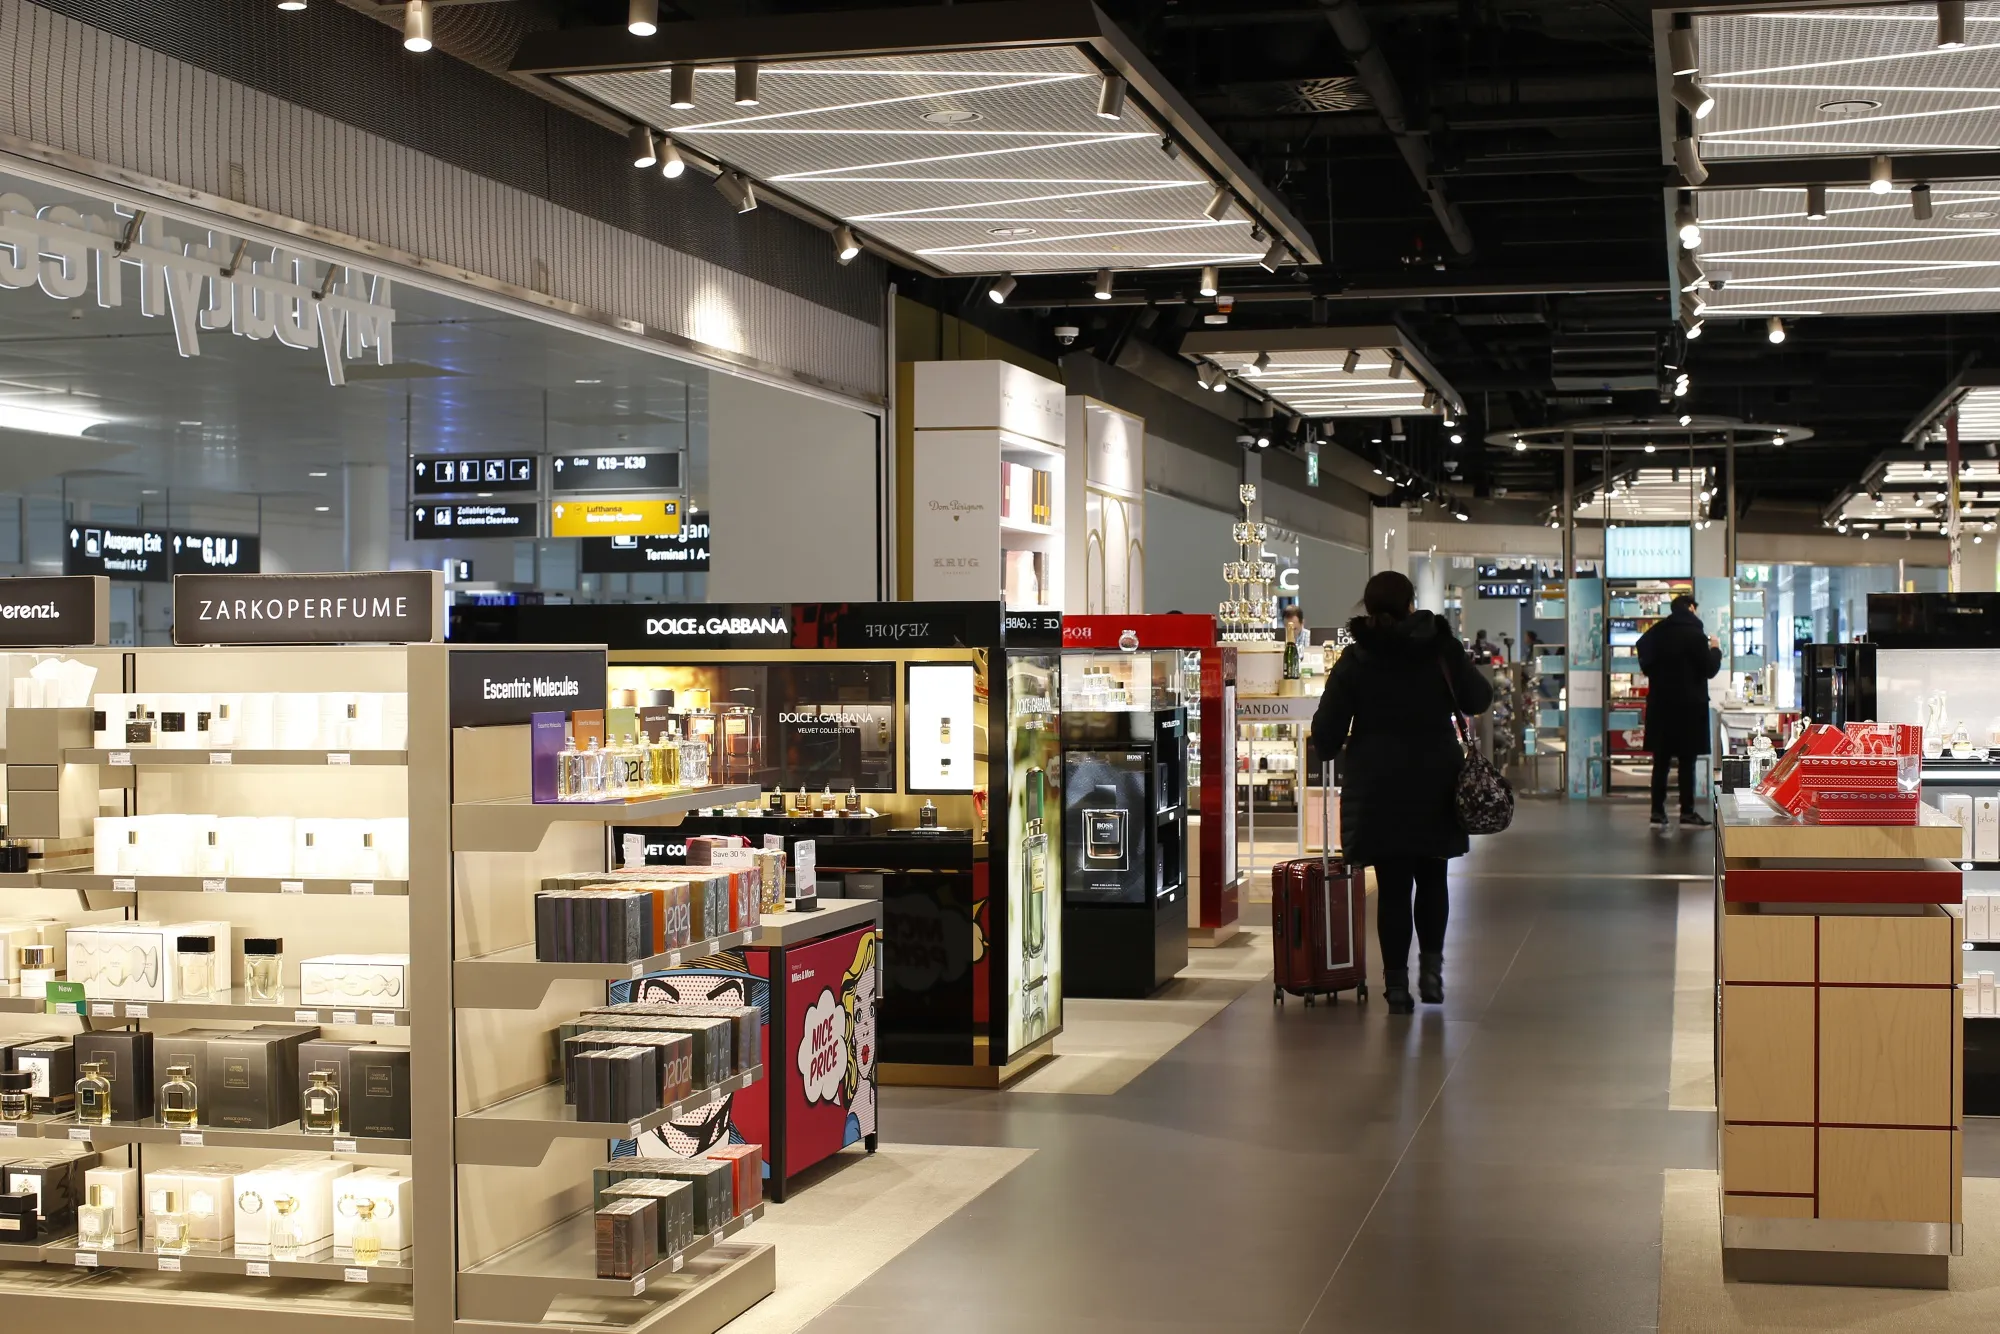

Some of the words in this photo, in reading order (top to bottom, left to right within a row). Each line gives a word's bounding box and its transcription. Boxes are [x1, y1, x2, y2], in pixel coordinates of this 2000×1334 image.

[574, 457, 589, 466] Gate
[457, 506, 506, 515] Zollabfertigung
[587, 505, 623, 513] Lufthansa
[457, 516, 485, 525] Customs
[485, 516, 519, 525] Clearance
[104, 530, 143, 554] Ausgang
[144, 532, 162, 553] Exit
[645, 548, 687, 561] Terminal
[690, 549, 695, 560] 1
[104, 557, 126, 570] Terminal
[933, 558, 980, 567] KRUG
[0, 601, 60, 619] erenzi.
[199, 596, 408, 621] ZARKOPERFUME
[483, 677, 531, 700] Escentric
[533, 675, 579, 697] Molecules
[1244, 704, 1289, 715] ANDON
[713, 850, 728, 858] Save
[791, 973, 801, 983] Miles
[801, 972, 804, 980] &
[804, 969, 815, 978] More
[58, 985, 73, 993] New
[812, 1013, 834, 1055] NICE
[810, 1039, 838, 1087] PRICE
